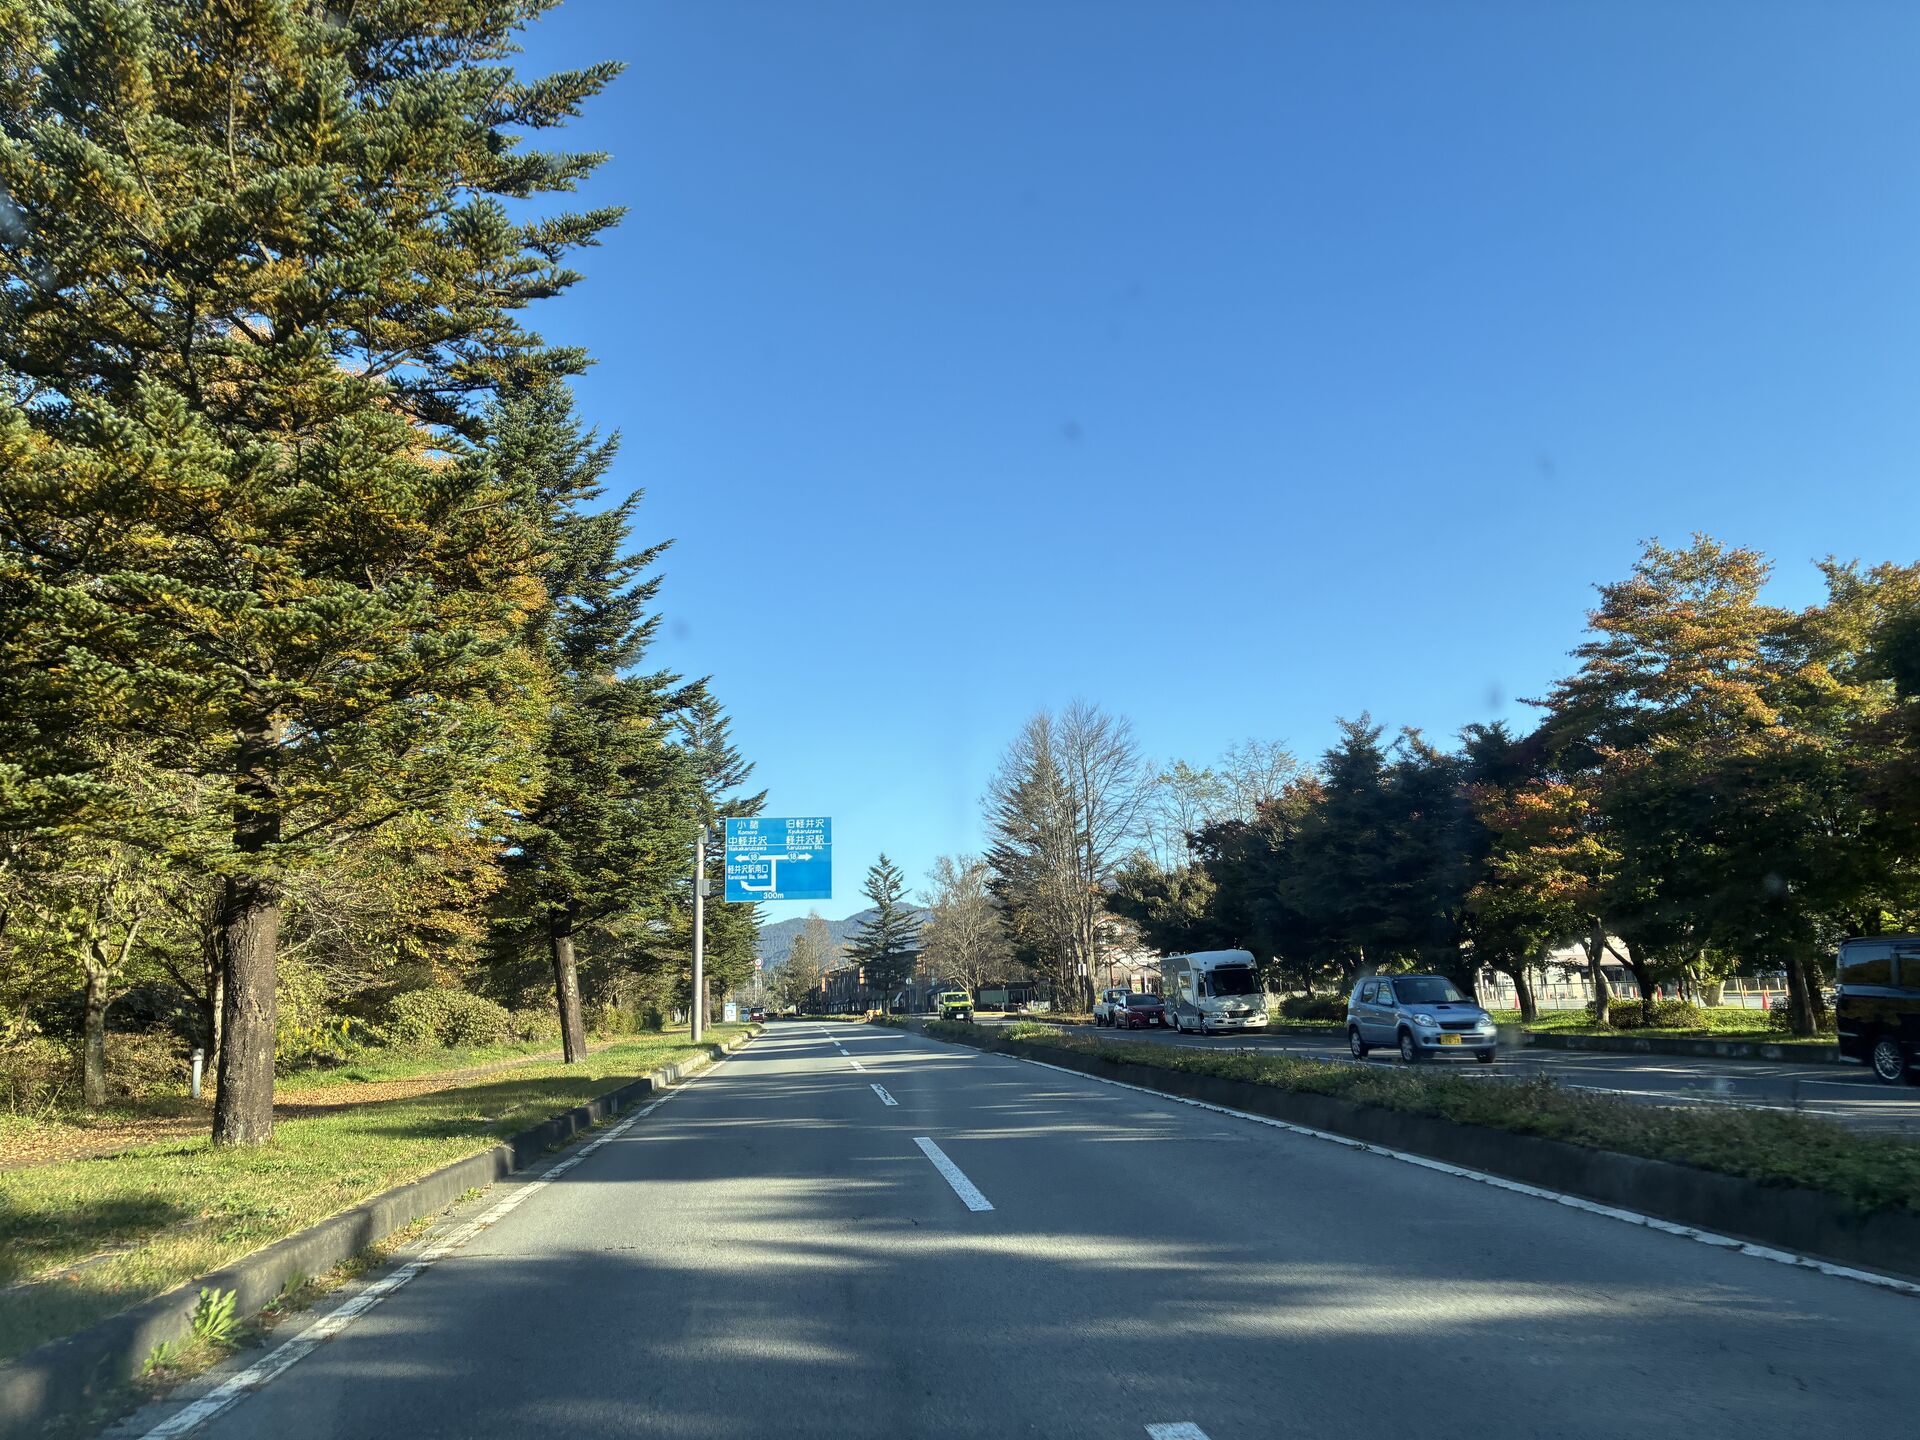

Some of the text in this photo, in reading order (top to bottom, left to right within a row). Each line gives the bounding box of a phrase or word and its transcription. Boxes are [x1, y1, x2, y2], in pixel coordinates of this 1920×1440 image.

[786, 818, 824, 828] 旧軽井沢
[728, 836, 768, 846] 中軽井沢
[786, 834, 824, 844] 軽井沢駅
[728, 864, 768, 874] 軽井沢駅南口
